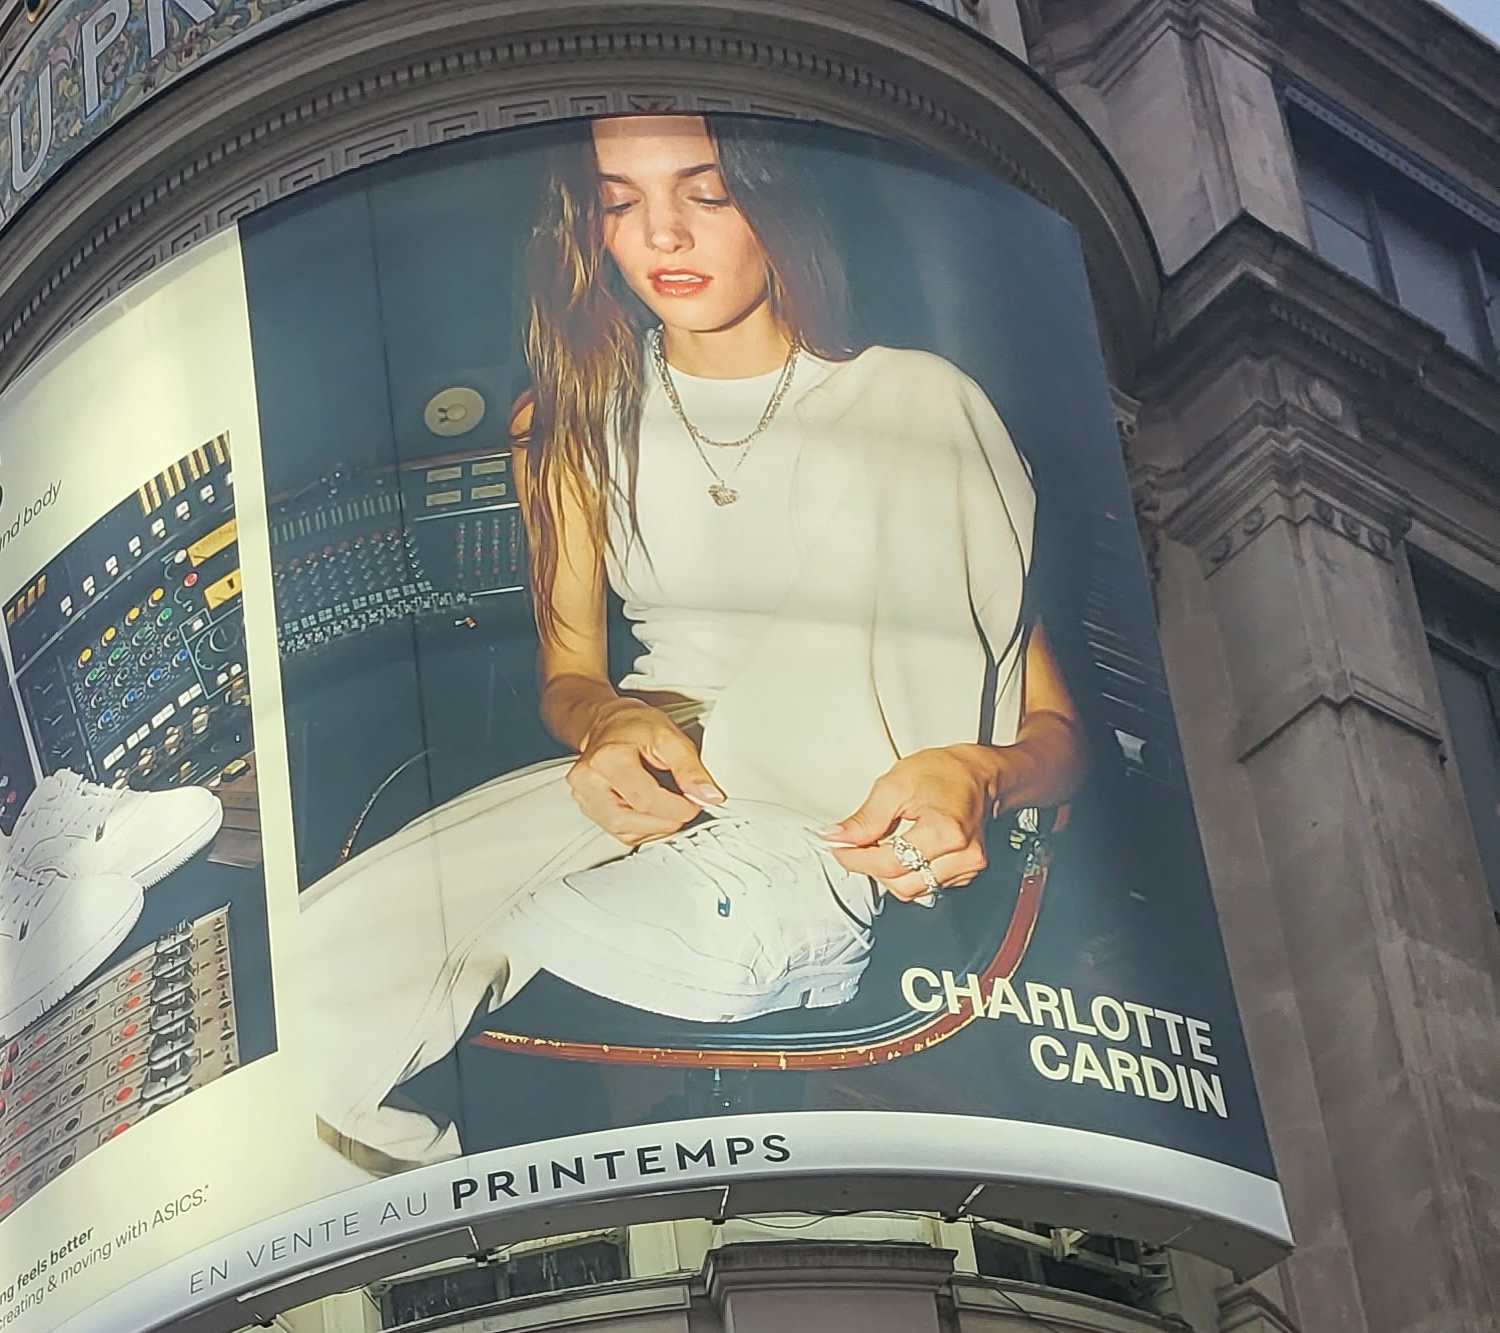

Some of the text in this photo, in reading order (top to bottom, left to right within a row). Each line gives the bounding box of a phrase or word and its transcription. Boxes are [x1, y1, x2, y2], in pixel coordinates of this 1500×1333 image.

[23, 479, 62, 527] body
[900, 966, 1218, 1066] CHARLOTTE
[1029, 1035, 1229, 1119] CARDIN
[190, 1134, 791, 1296] EN VENTE AU PRINTEMPS
[17, 1258, 48, 1290] feels
[49, 1226, 94, 1266] better
[47, 1274, 58, 1292] &
[60, 1240, 112, 1283] moving
[115, 1220, 148, 1249] with
